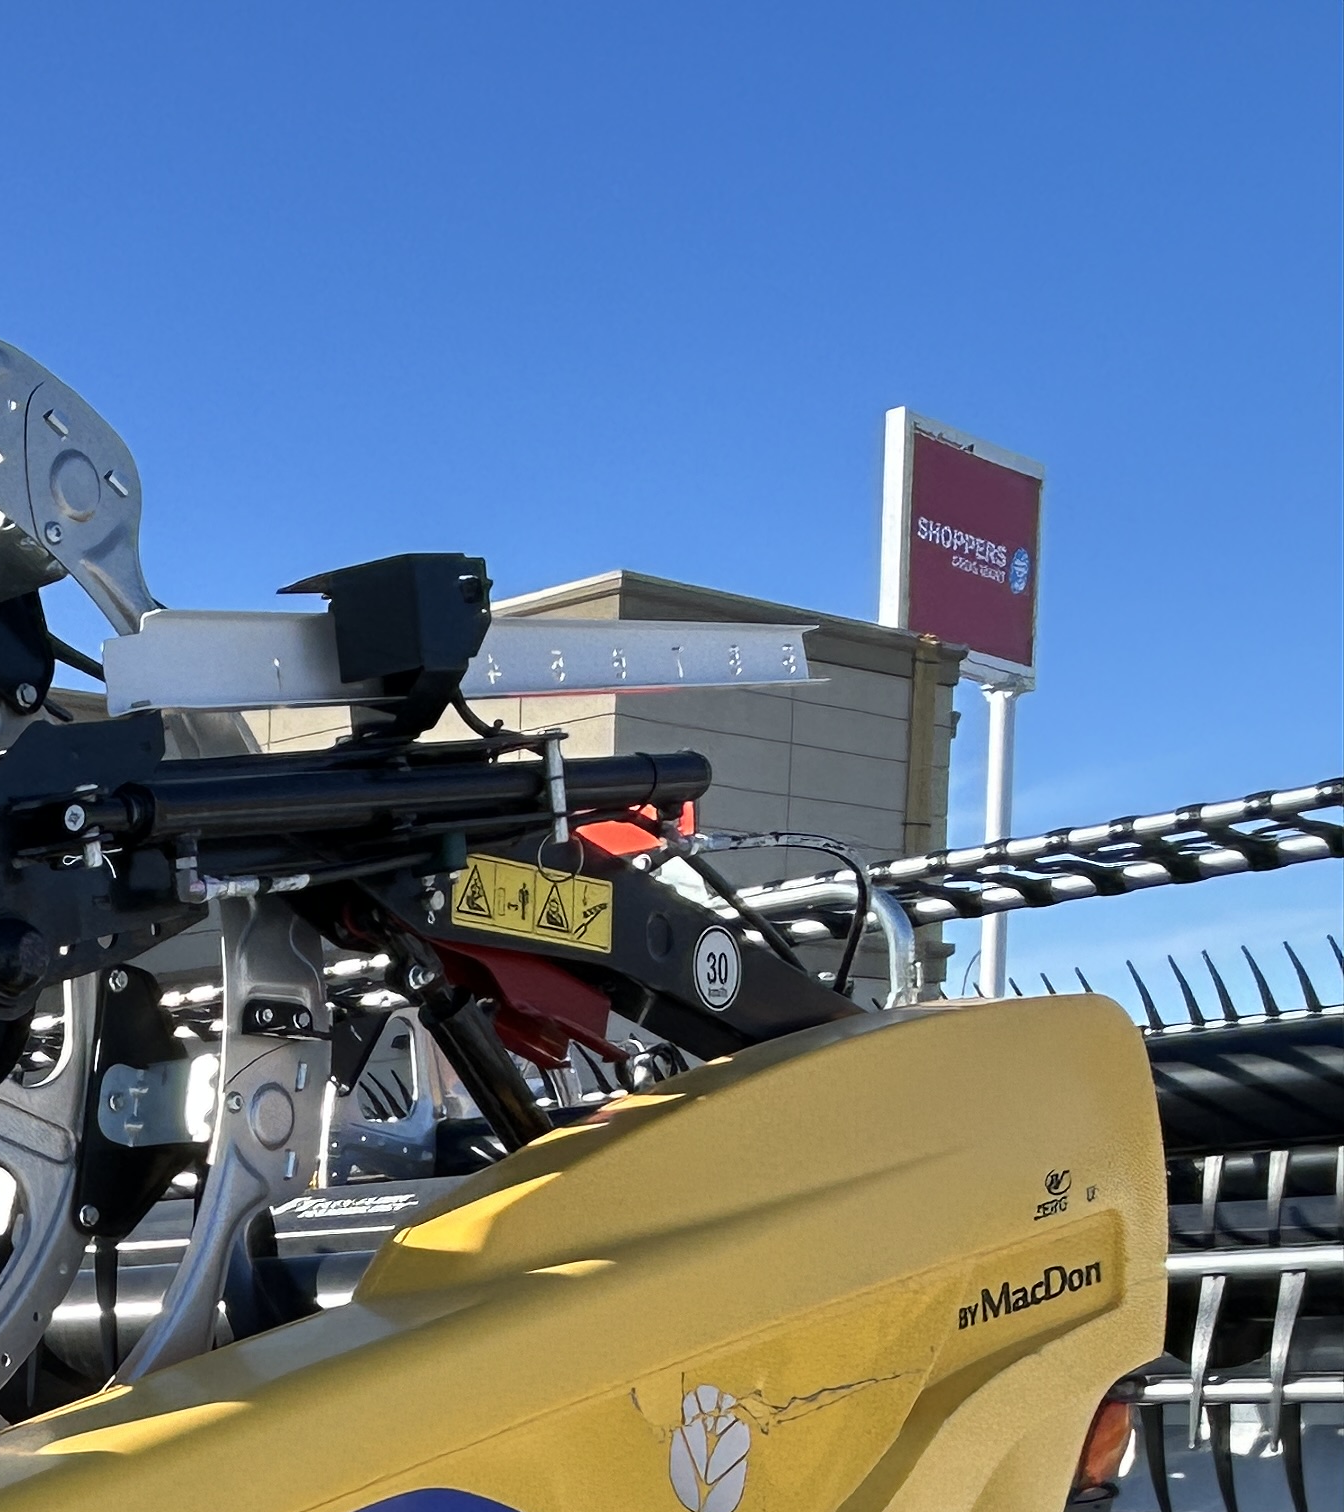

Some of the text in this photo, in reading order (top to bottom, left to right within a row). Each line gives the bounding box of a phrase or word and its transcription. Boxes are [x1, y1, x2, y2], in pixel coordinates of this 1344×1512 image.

[917, 516, 1007, 568] SHOPPERS
[707, 951, 728, 985] 30
[958, 1262, 1102, 1330] BY MacDon
